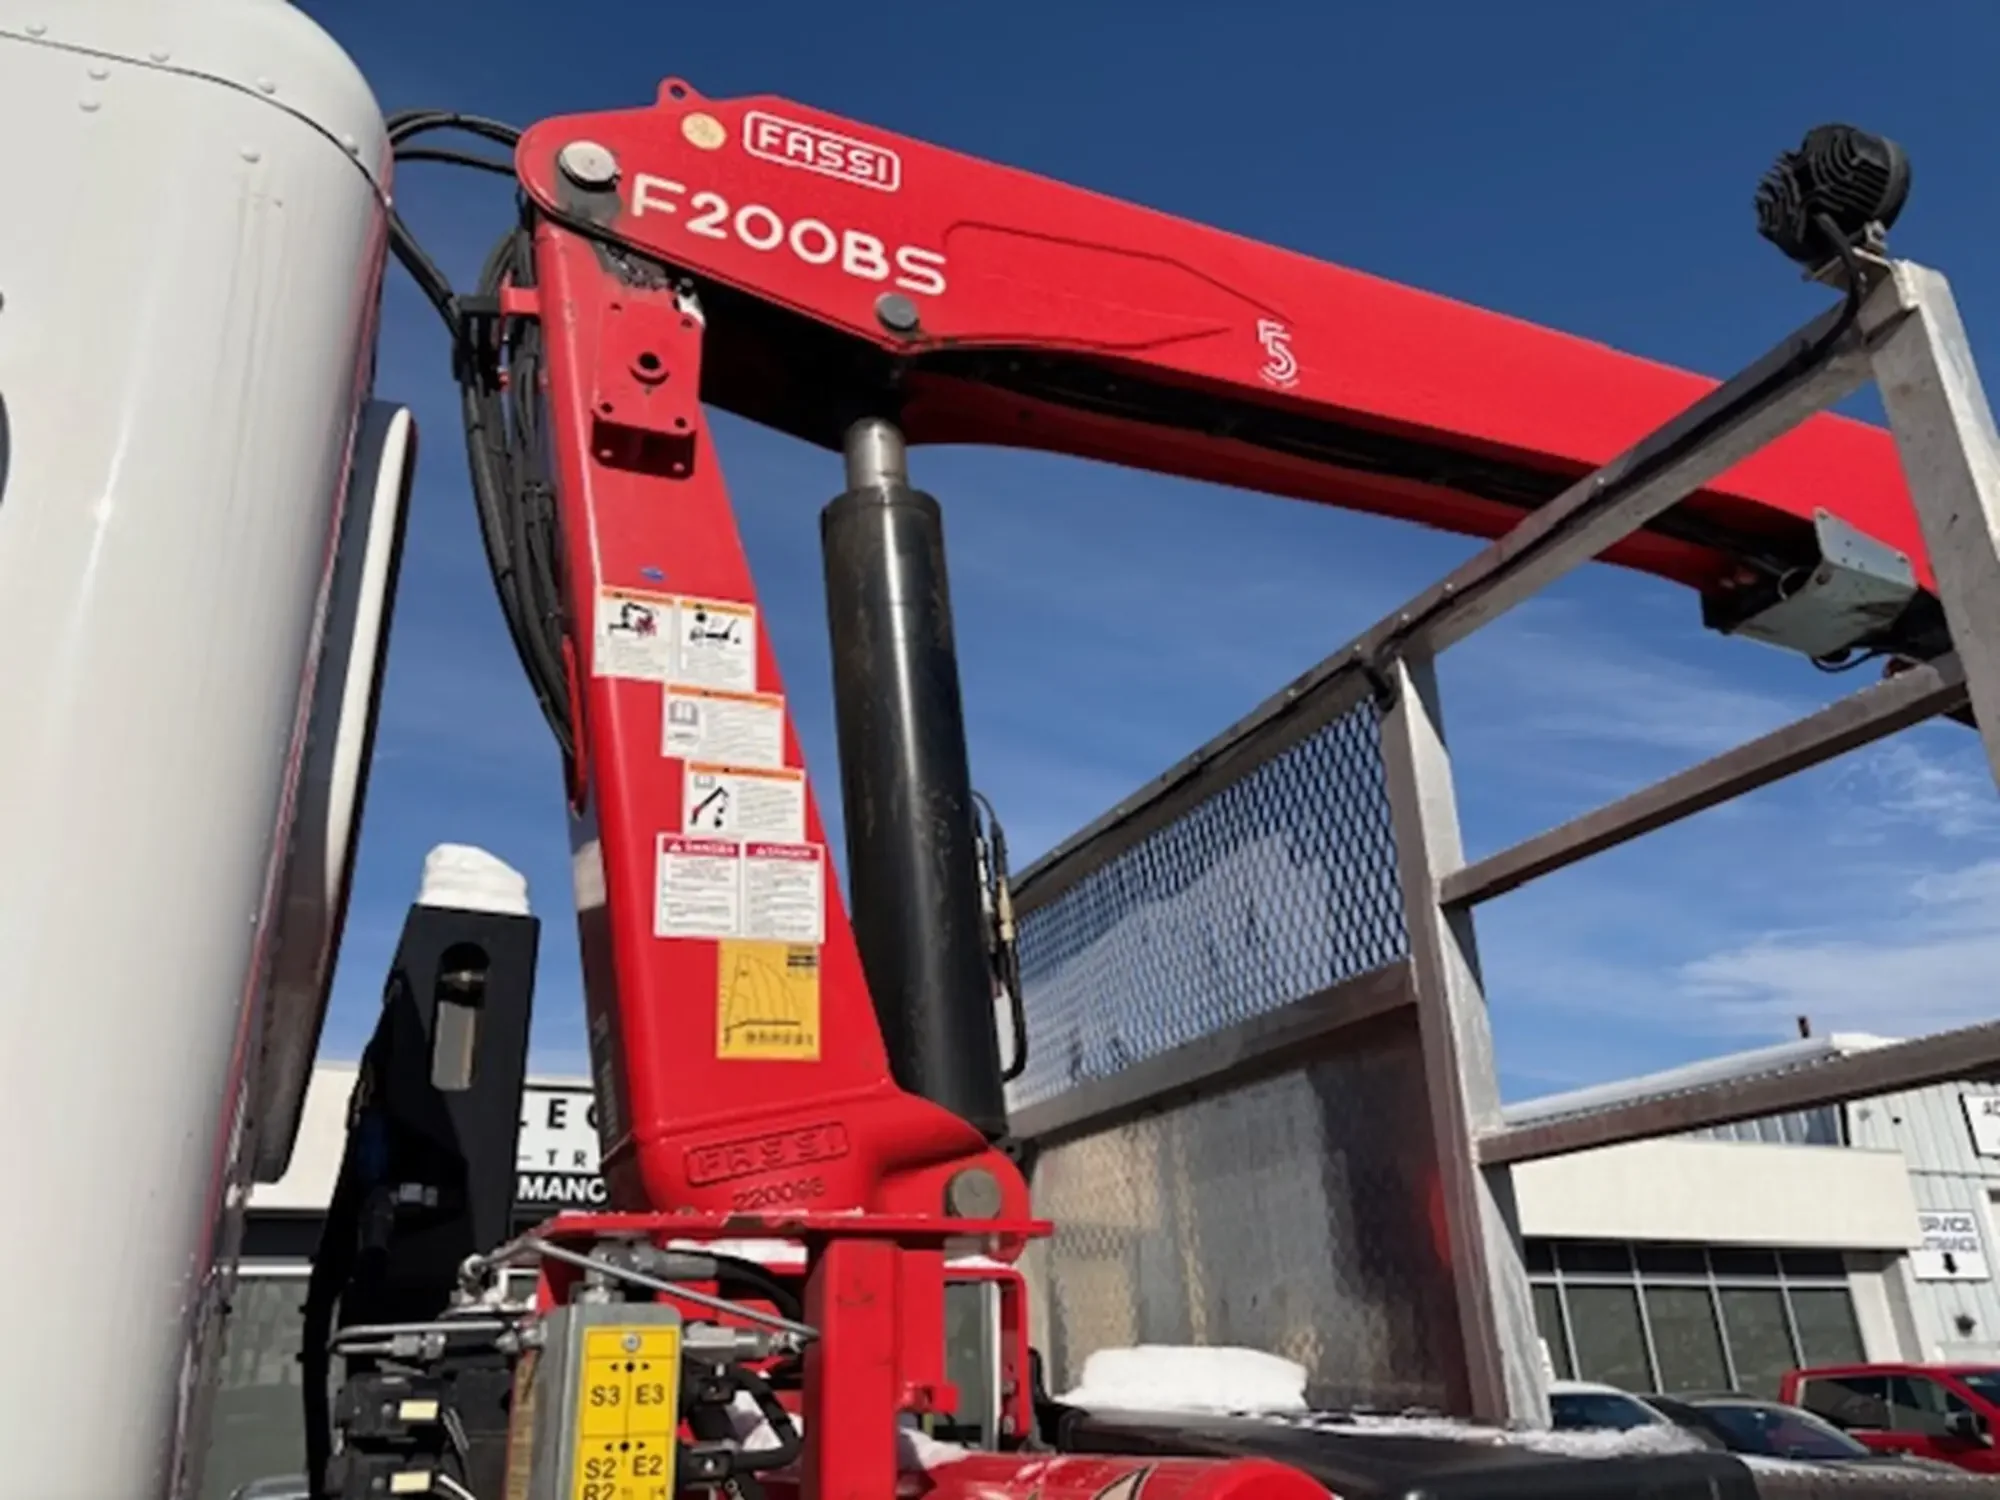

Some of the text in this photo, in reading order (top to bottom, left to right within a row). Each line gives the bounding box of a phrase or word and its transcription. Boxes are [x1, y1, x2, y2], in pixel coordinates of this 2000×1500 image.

[757, 121, 889, 182] FASSI
[630, 173, 947, 296] F200BS
[695, 1126, 838, 1180] FASSI
[590, 1384, 621, 1407] S3
[635, 1383, 665, 1406] E3
[584, 1457, 617, 1480] S2
[631, 1454, 663, 1477] E2
